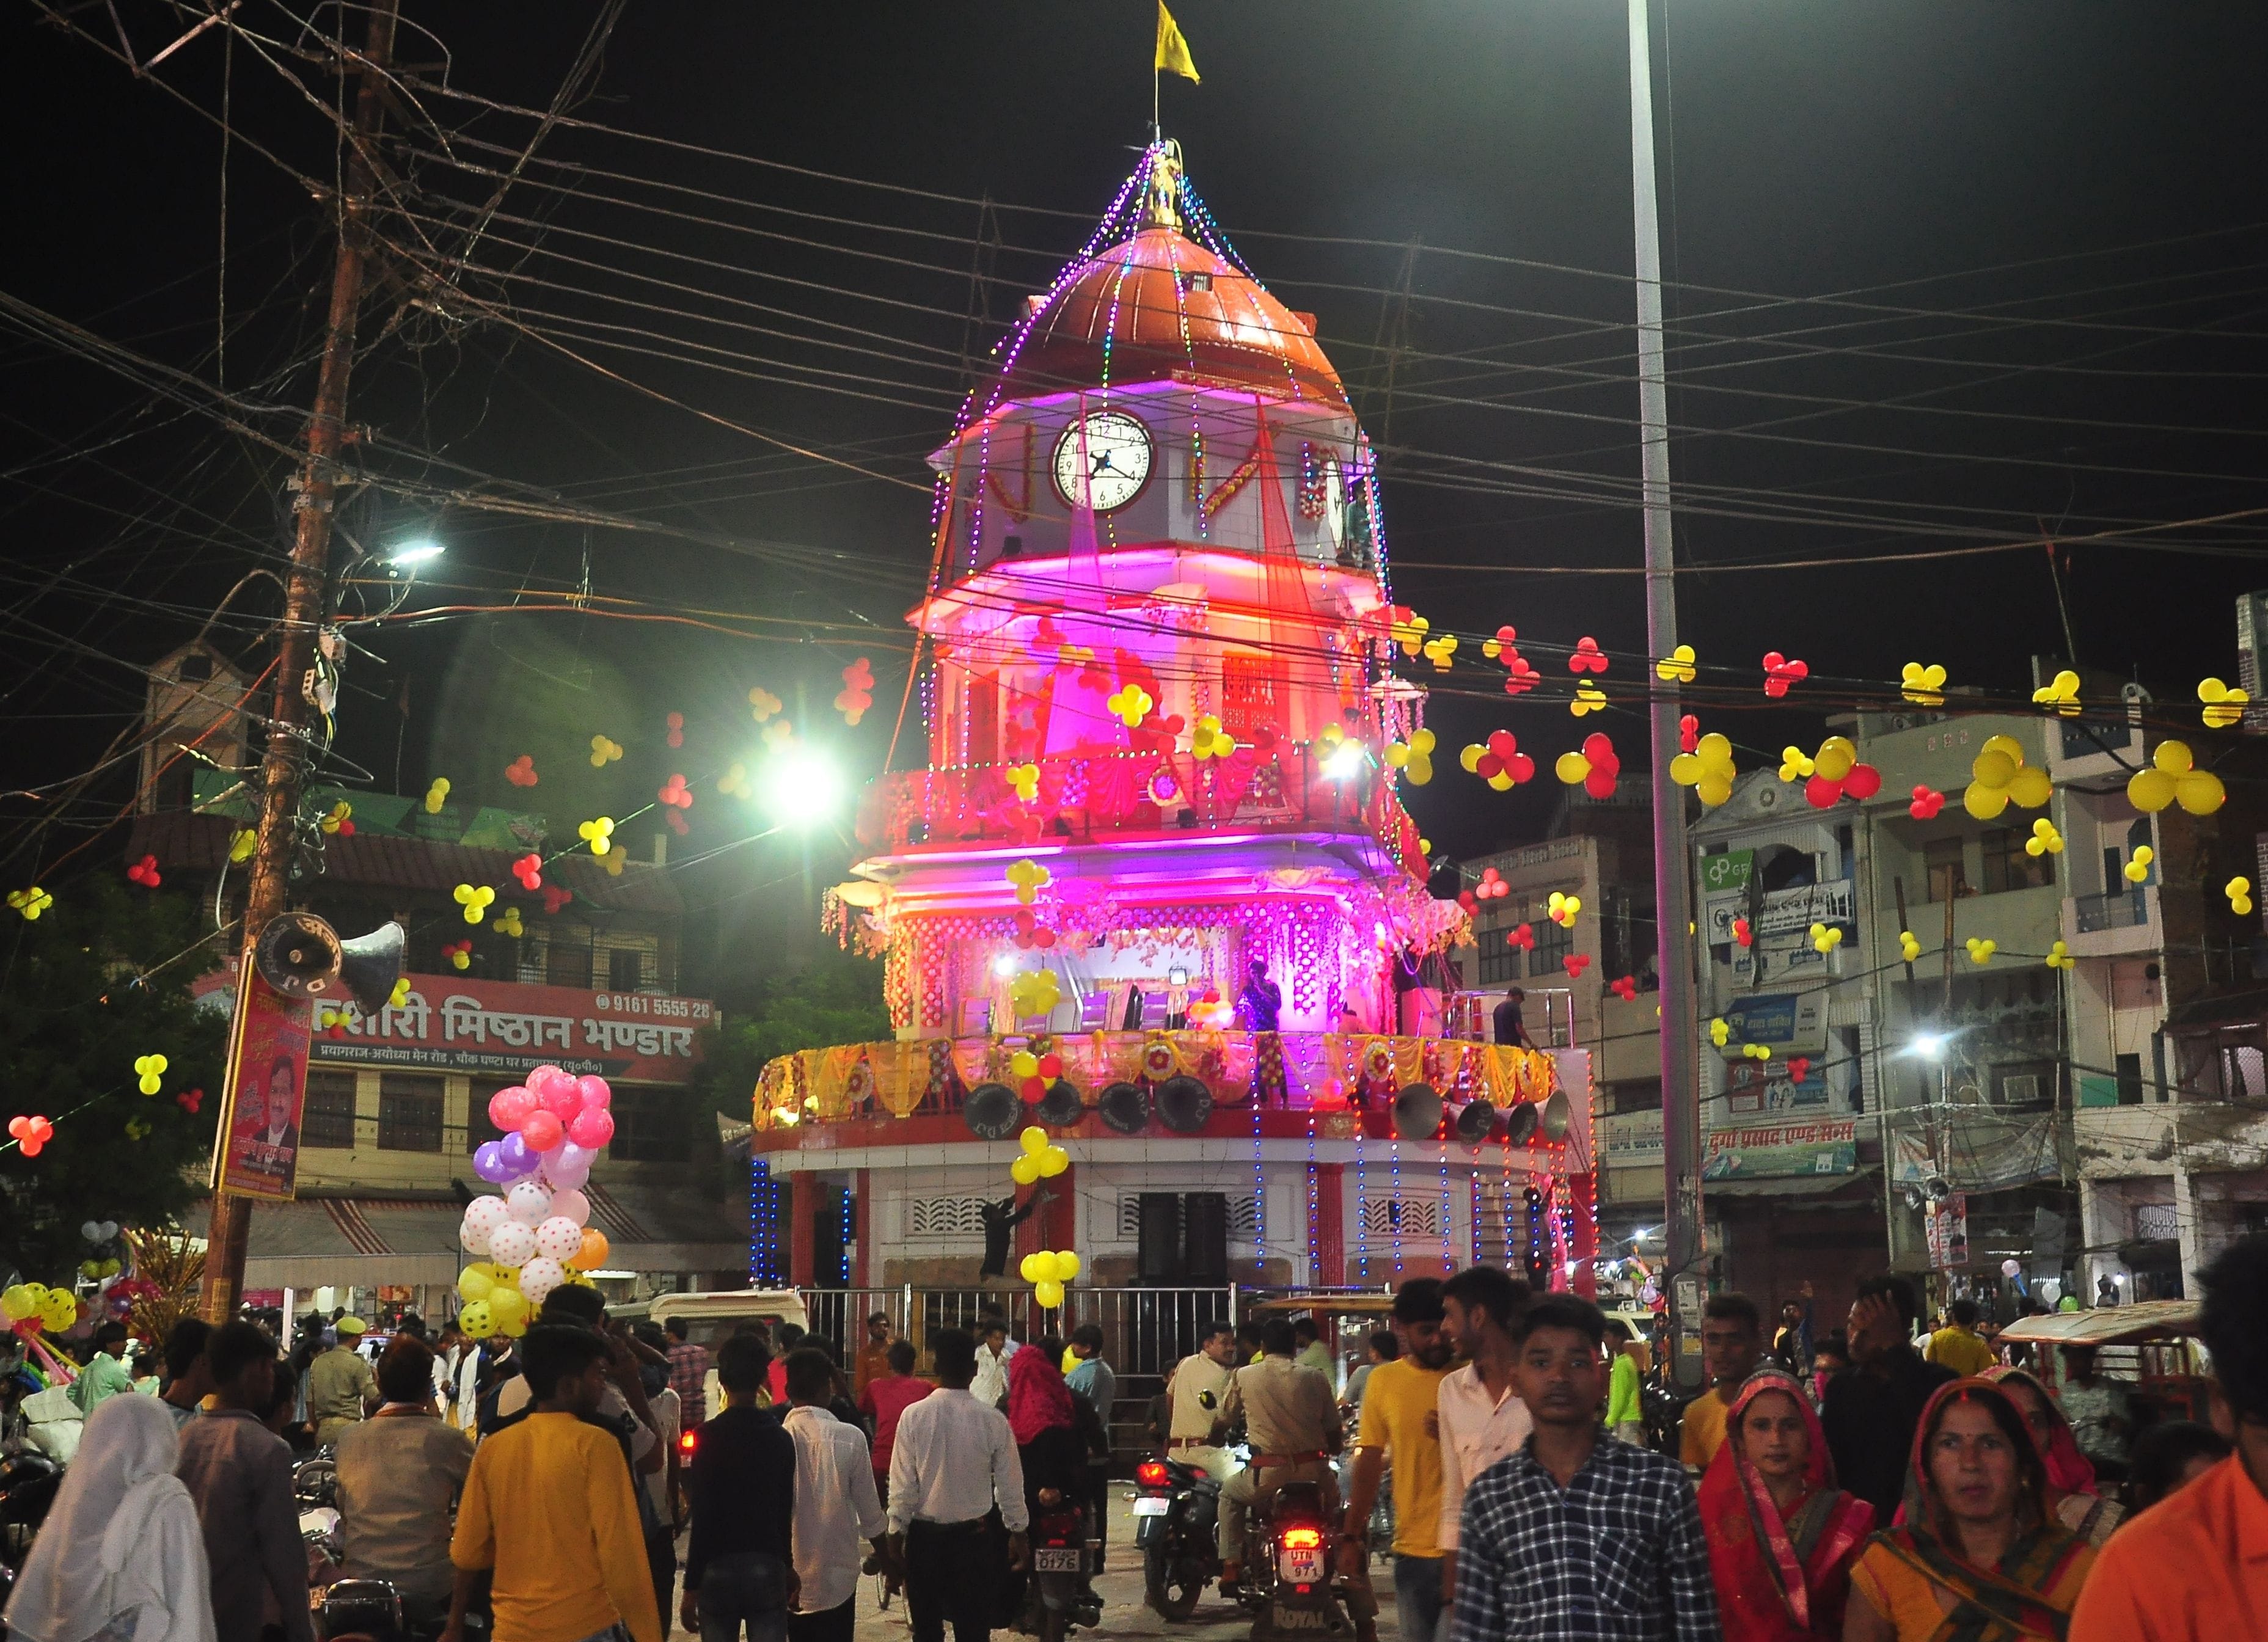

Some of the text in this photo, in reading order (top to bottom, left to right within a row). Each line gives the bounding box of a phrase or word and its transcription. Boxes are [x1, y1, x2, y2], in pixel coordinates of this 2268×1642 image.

[1099, 425, 1111, 437] 12
[1129, 437, 1135, 447] 2
[1135, 453, 1141, 464] 3
[1066, 461, 1072, 471] 9
[1071, 477, 1078, 488] 8
[1116, 483, 1123, 494] 5
[1099, 491, 1105, 501] 6
[654, 998, 689, 1017] 5555
[441, 995, 574, 1048] मिष्ठान
[583, 1018, 695, 1057] भण्डार
[455, 1050, 478, 1065] चौक
[507, 1057, 520, 1068] घर
[1291, 1551, 1312, 1560] UTN
[1039, 1557, 1075, 1569] 0176
